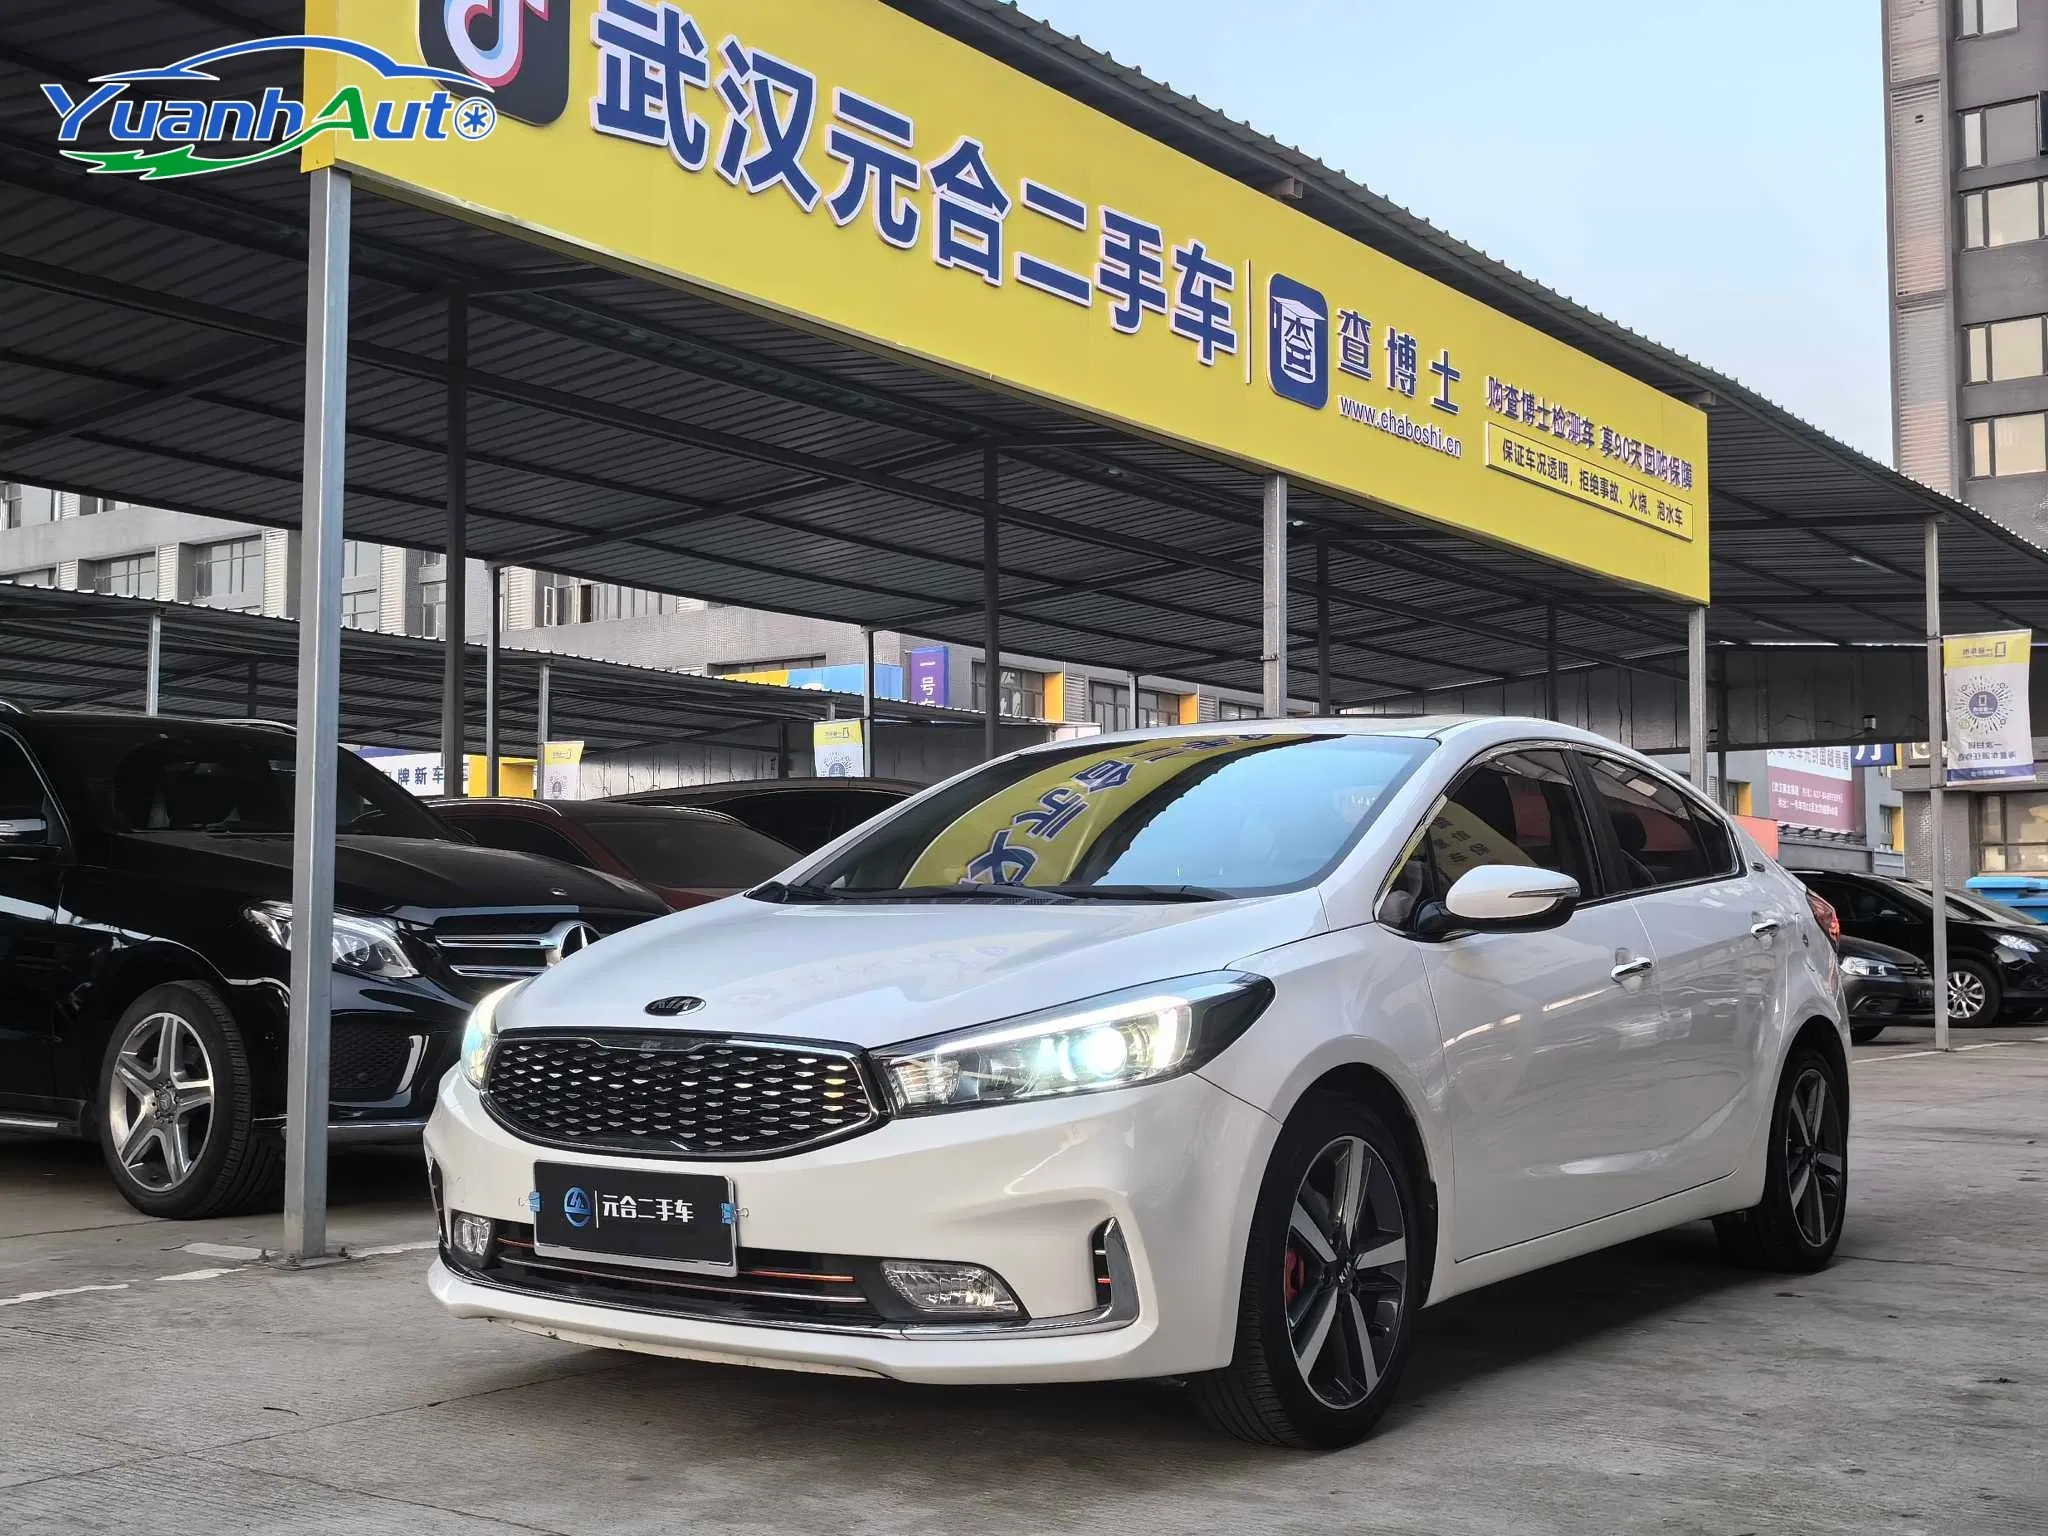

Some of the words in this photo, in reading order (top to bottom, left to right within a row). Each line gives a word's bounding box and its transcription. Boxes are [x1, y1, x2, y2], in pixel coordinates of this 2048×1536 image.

[590, 1, 1237, 365] 武汉元合二手车
[1336, 308, 1461, 415] 查博士
[1339, 396, 1462, 459] www.chaboshi.cn
[1486, 375, 1595, 450] 购查博士检测车
[602, 1193, 694, 1224] 元合二手车
